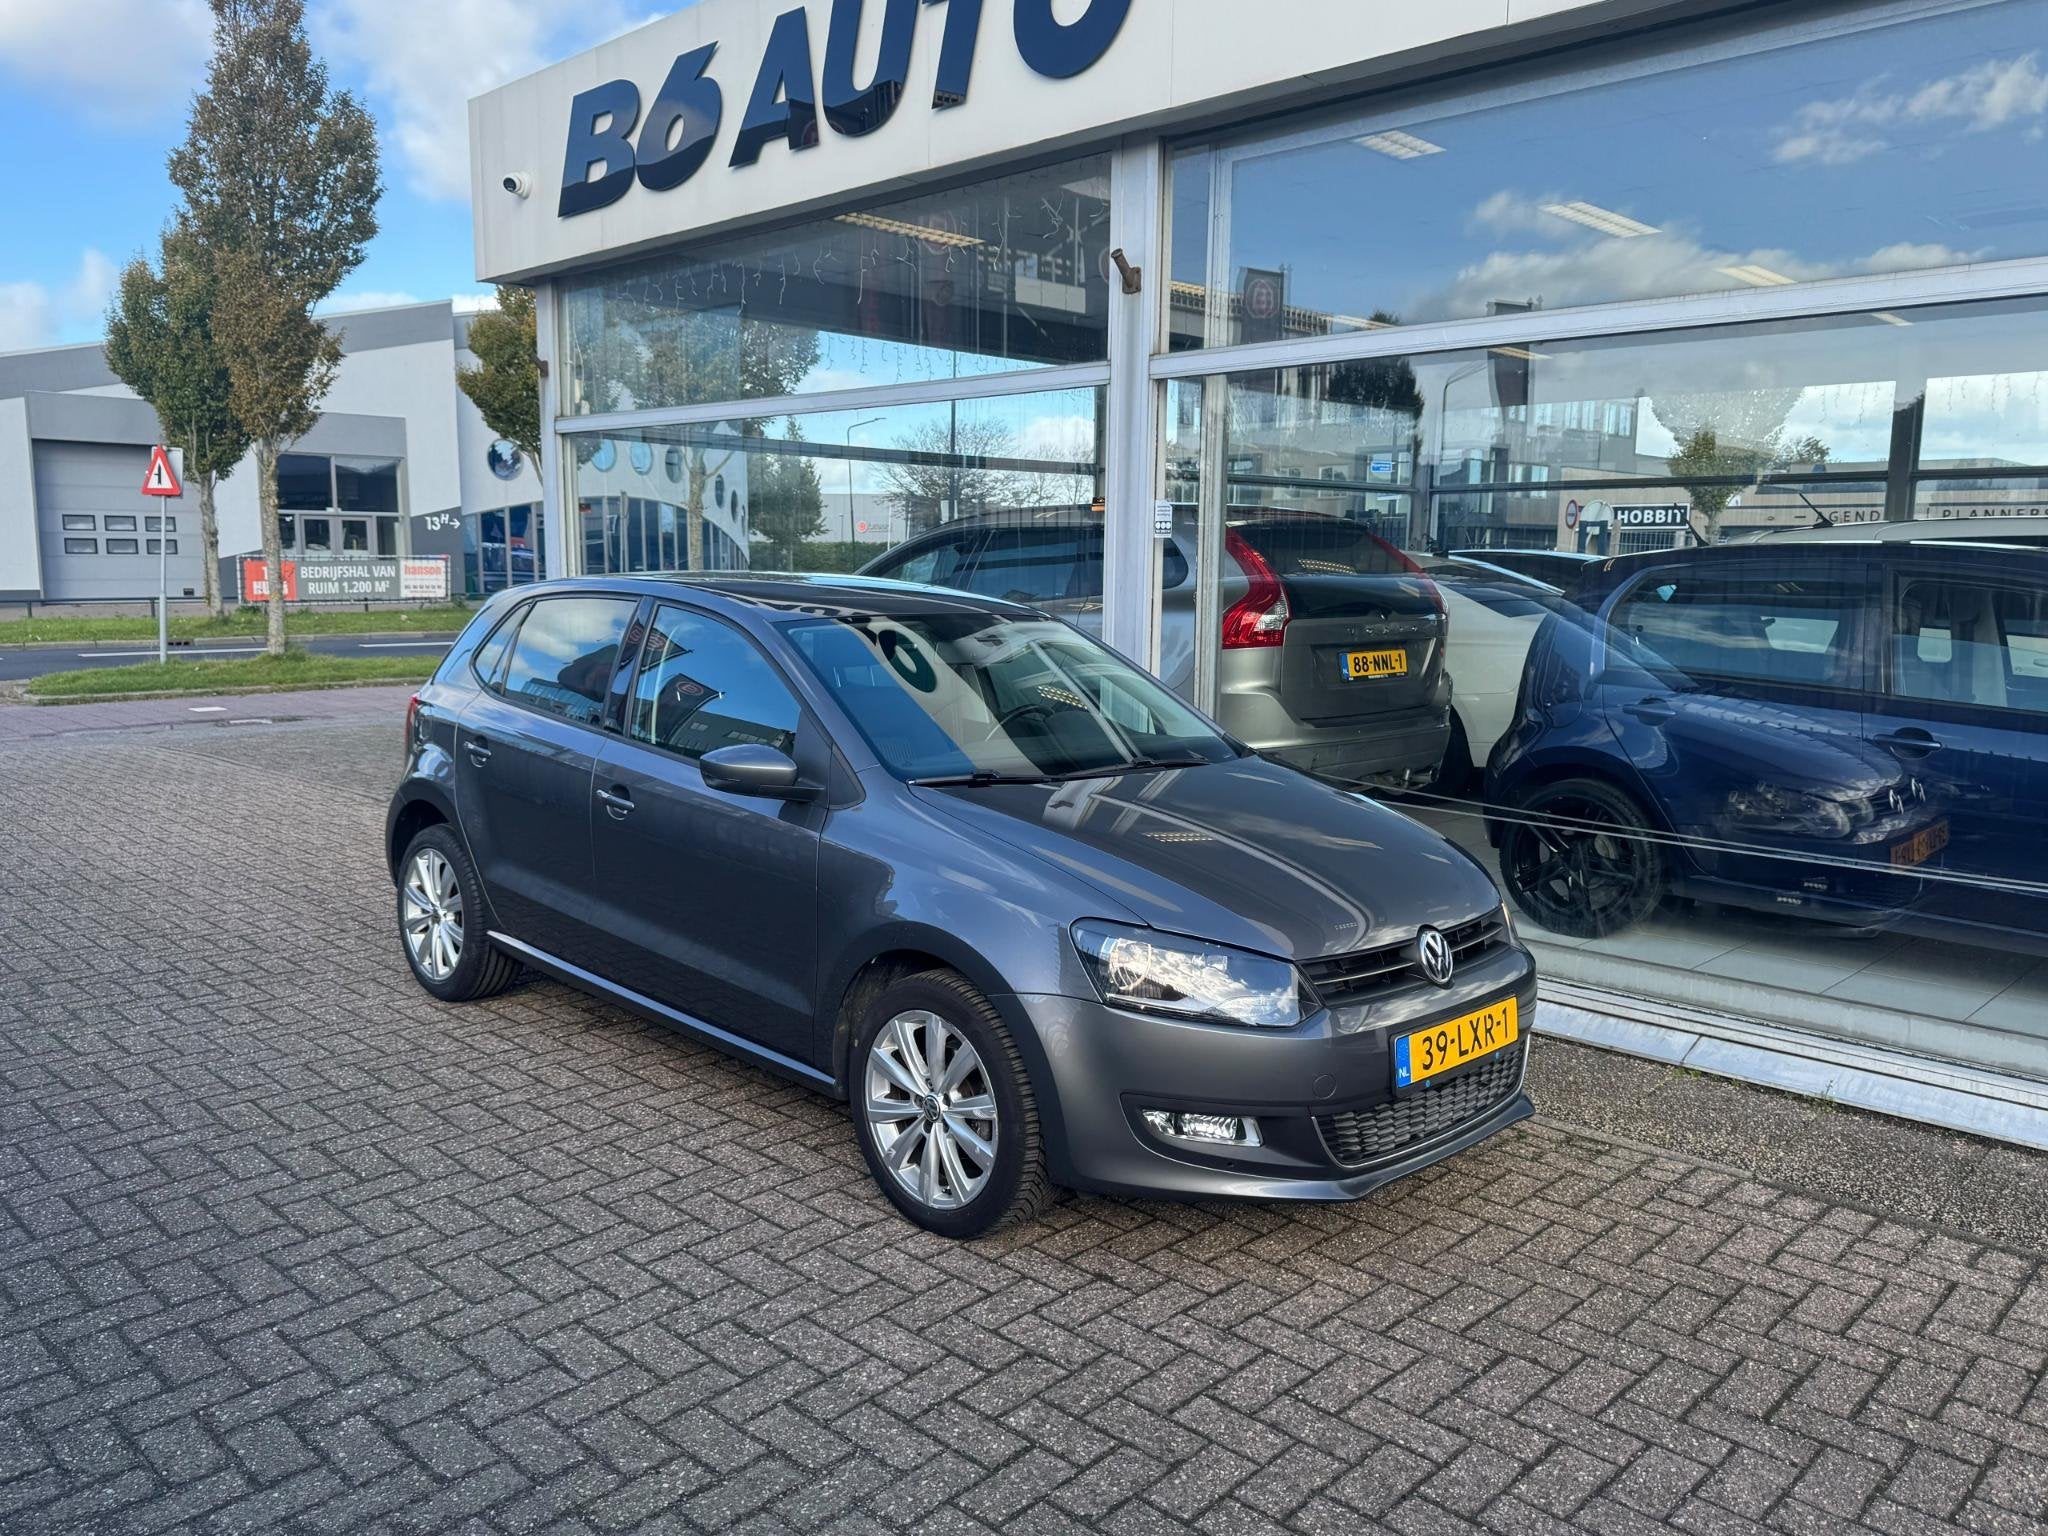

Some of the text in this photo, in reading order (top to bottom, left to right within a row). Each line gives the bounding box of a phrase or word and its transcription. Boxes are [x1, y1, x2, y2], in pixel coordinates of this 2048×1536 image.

[558, 0, 1132, 218] B6 AUTO
[1617, 509, 1684, 524] HOBBIT
[301, 565, 396, 581] BEDRIJFSHAL VAN
[308, 581, 340, 594] RUIM
[342, 580, 372, 594] 1.200
[1353, 653, 1403, 673] 88-NNL-1
[1422, 1007, 1508, 1071] 39-LXR-1
[1398, 1065, 1410, 1079] NL
